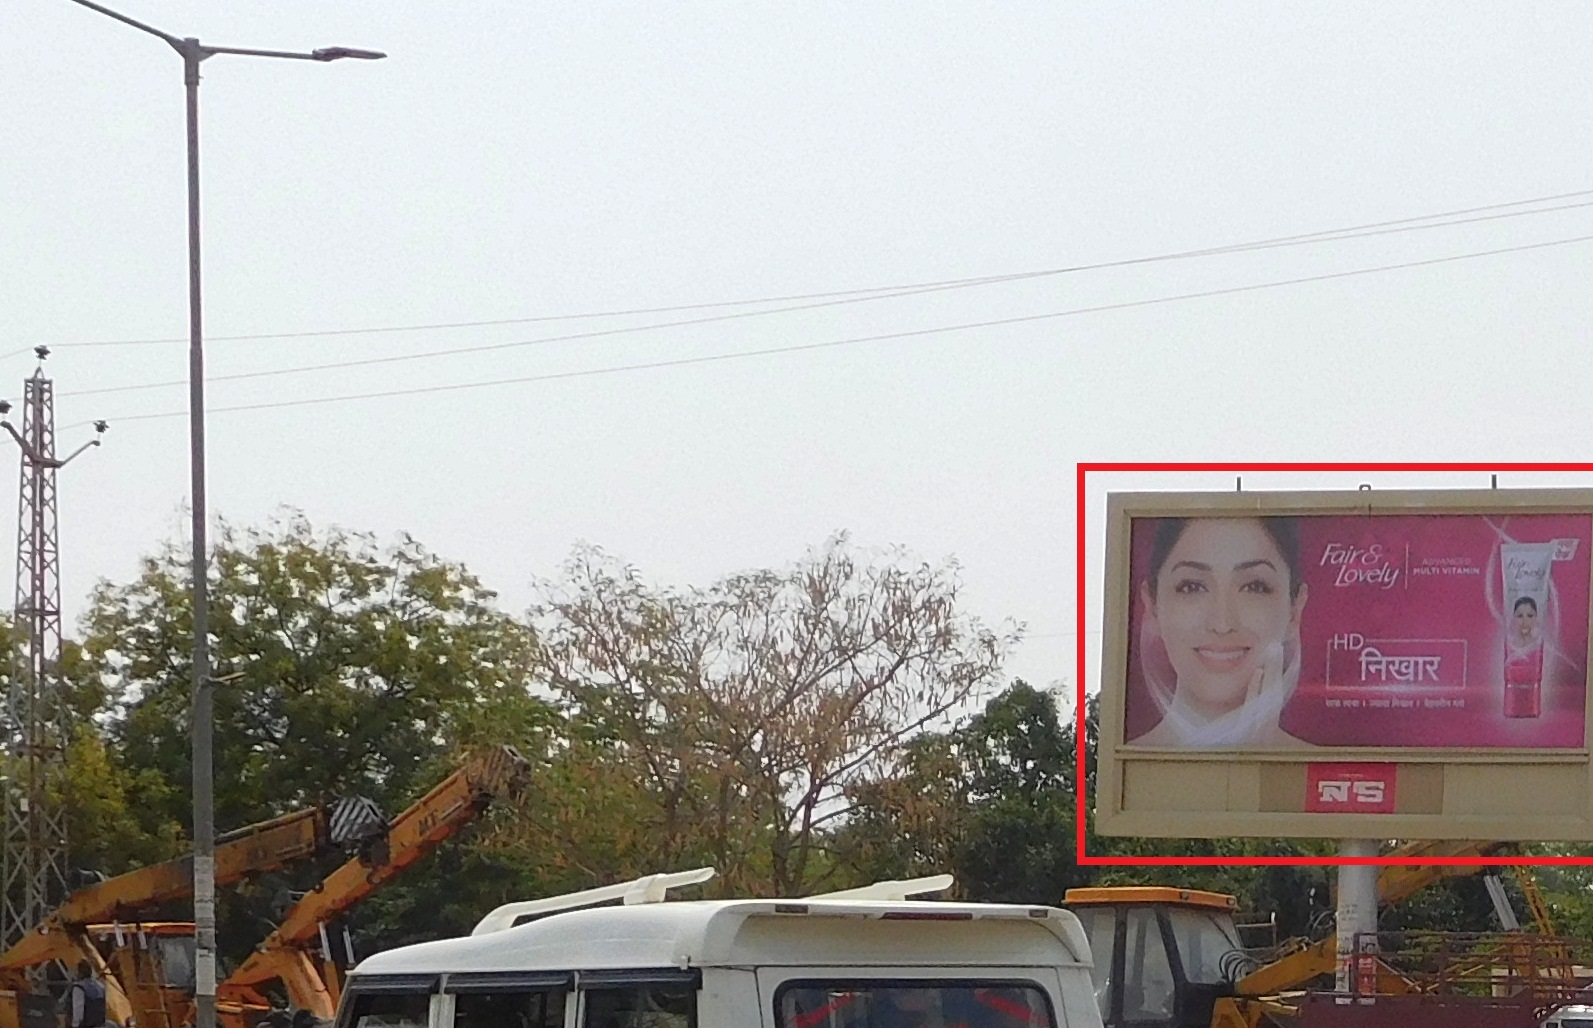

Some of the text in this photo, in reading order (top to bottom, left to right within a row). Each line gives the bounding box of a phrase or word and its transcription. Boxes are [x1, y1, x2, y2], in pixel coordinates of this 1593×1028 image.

[1320, 543, 1383, 566] Fair &
[1334, 562, 1400, 590] Lovely
[1413, 567, 1481, 575] MULTI VITAMIN
[1334, 633, 1364, 651] HD
[1359, 647, 1441, 681] निखार
